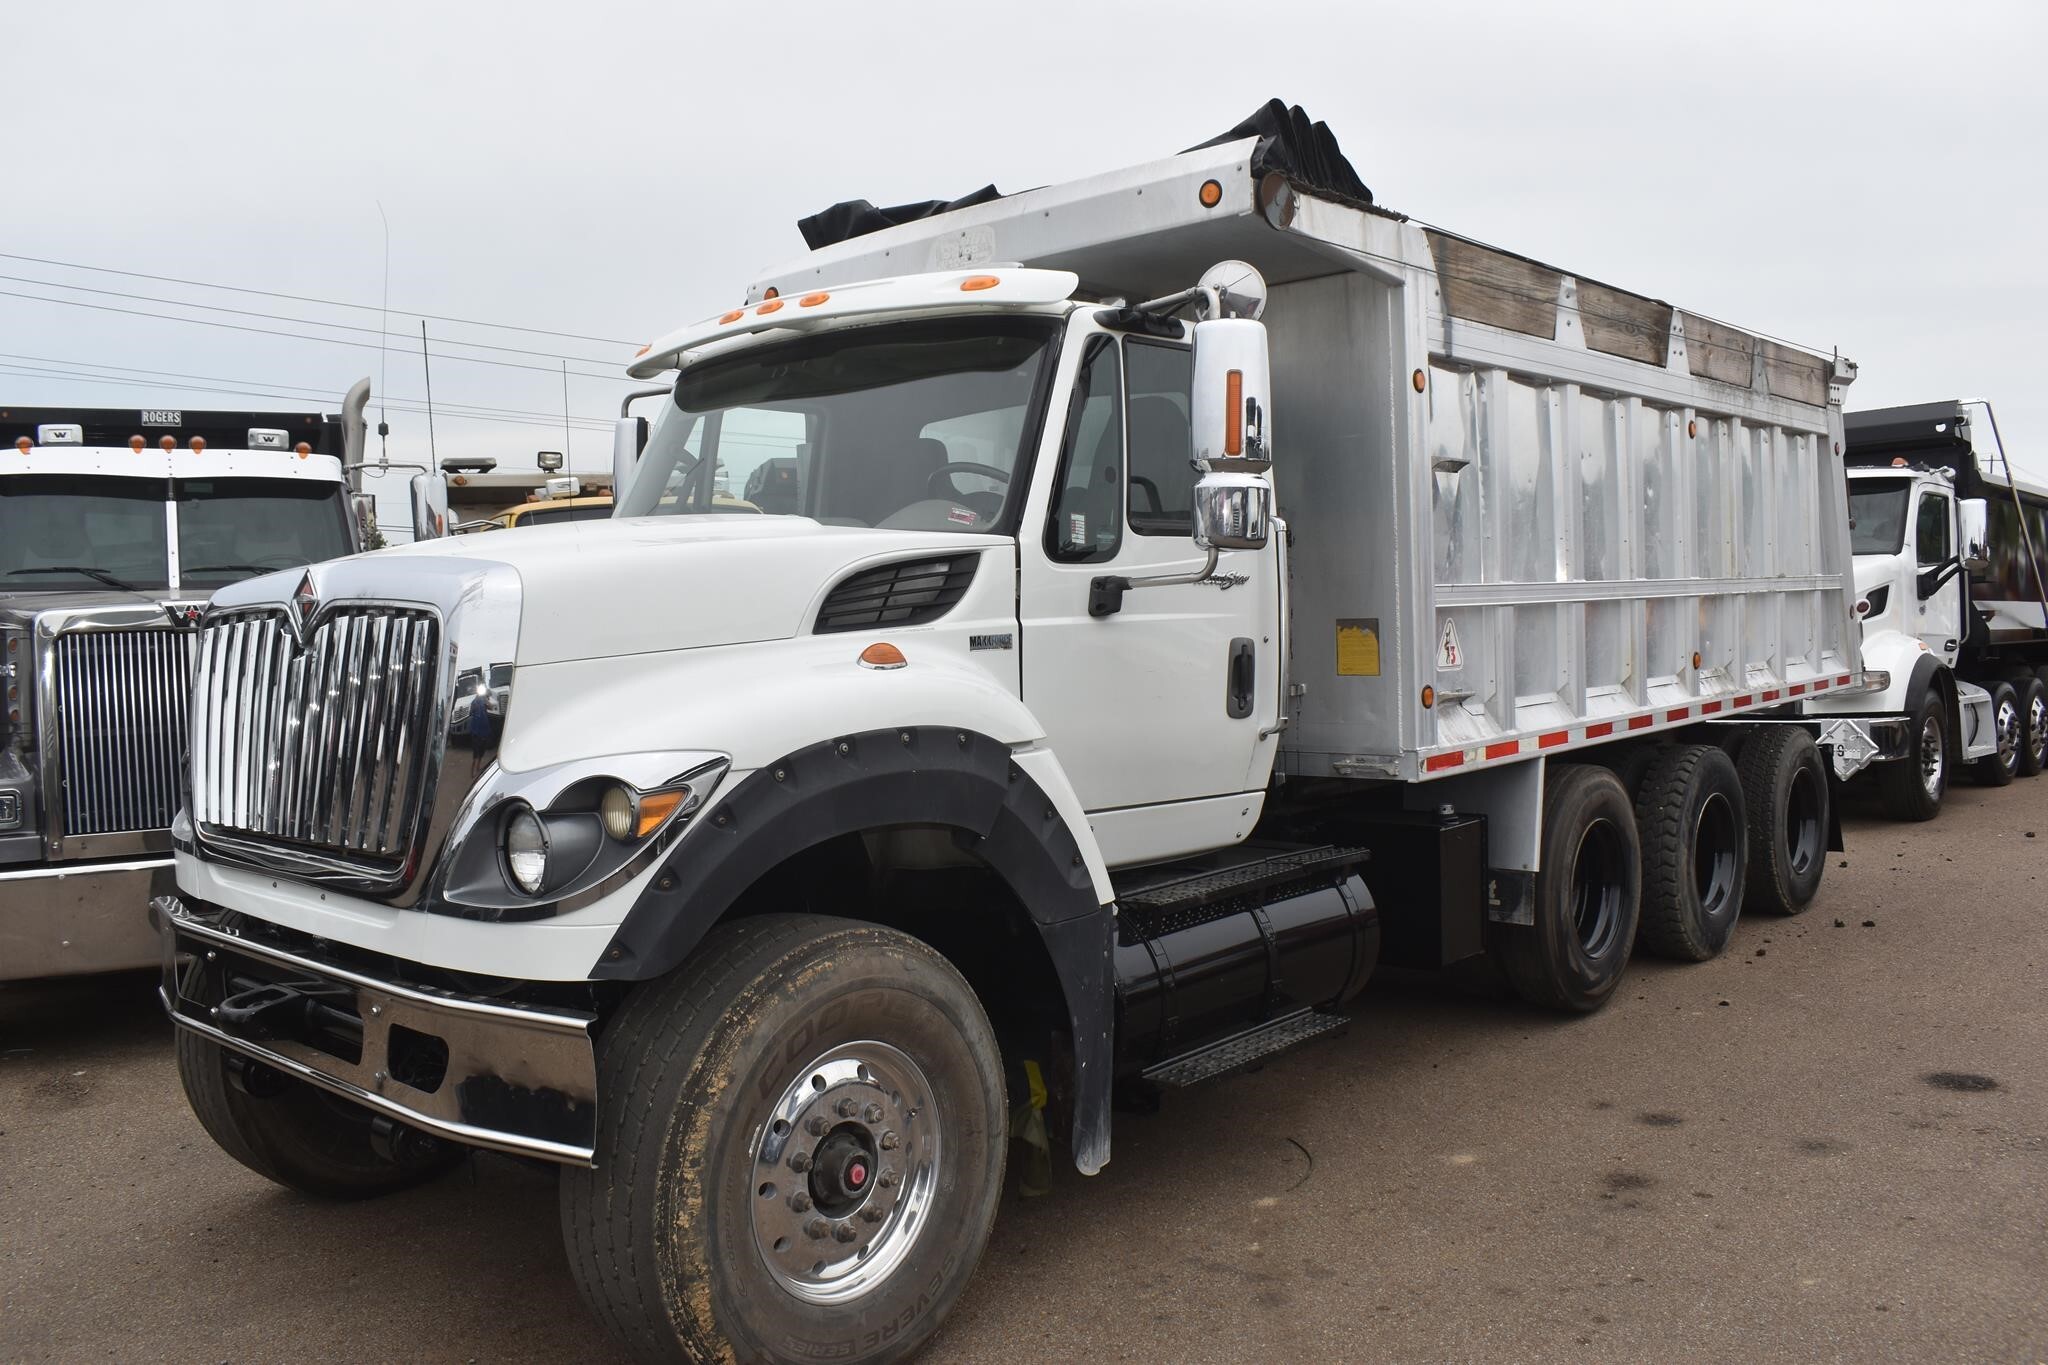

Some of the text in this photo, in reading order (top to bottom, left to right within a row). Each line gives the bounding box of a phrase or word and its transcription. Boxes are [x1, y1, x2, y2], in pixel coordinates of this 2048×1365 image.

[143, 411, 181, 423] ROGERS
[969, 633, 1013, 648] MAXXFORCE
[780, 1249, 959, 1358] SEVERE SERIES
